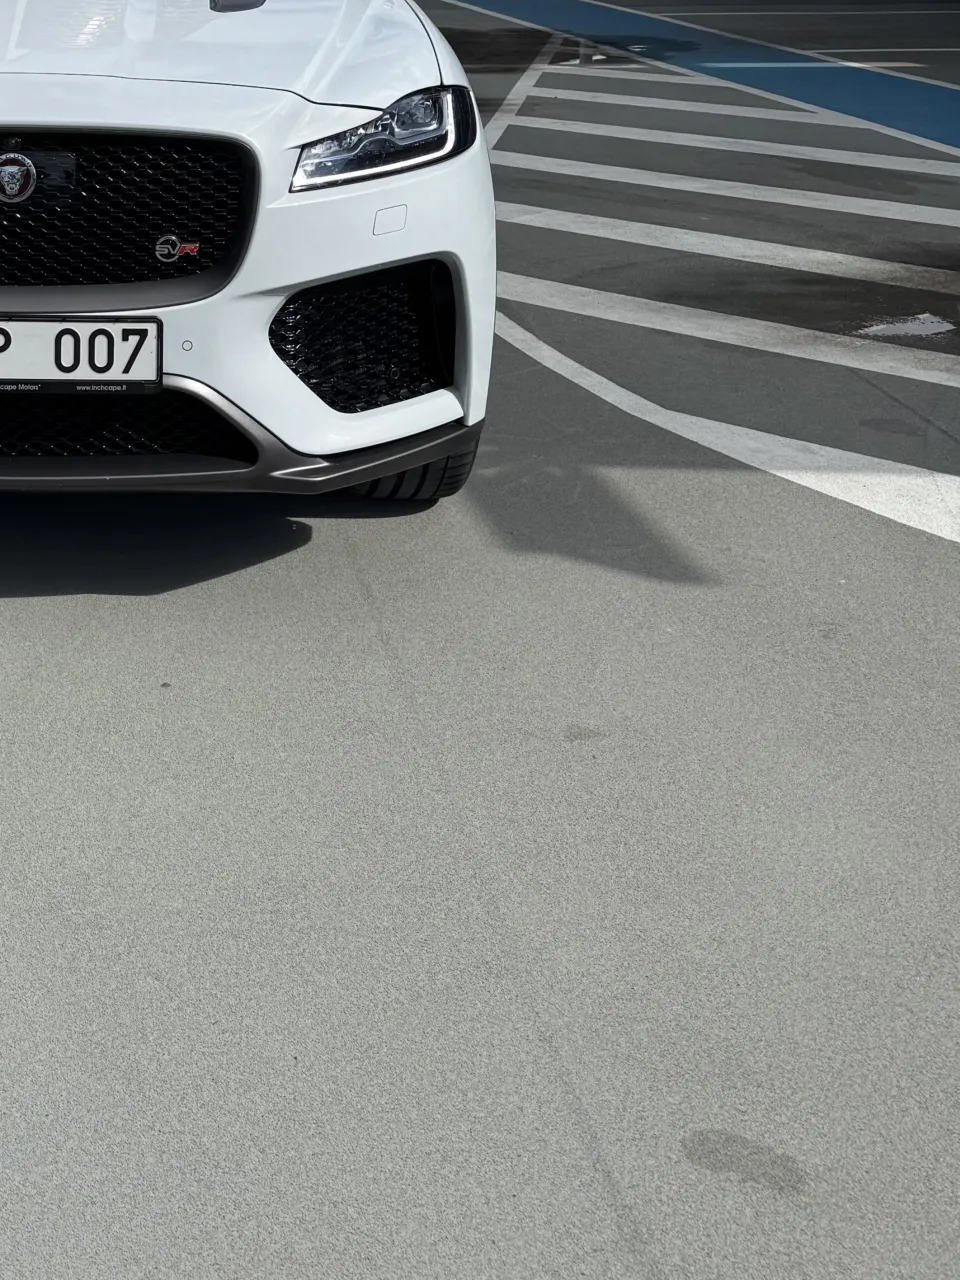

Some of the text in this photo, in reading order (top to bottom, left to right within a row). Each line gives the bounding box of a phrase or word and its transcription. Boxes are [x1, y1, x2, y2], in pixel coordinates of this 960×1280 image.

[155, 239, 200, 258] SVR
[54, 328, 149, 374] 007
[75, 384, 127, 392] www.inchcape.lt
